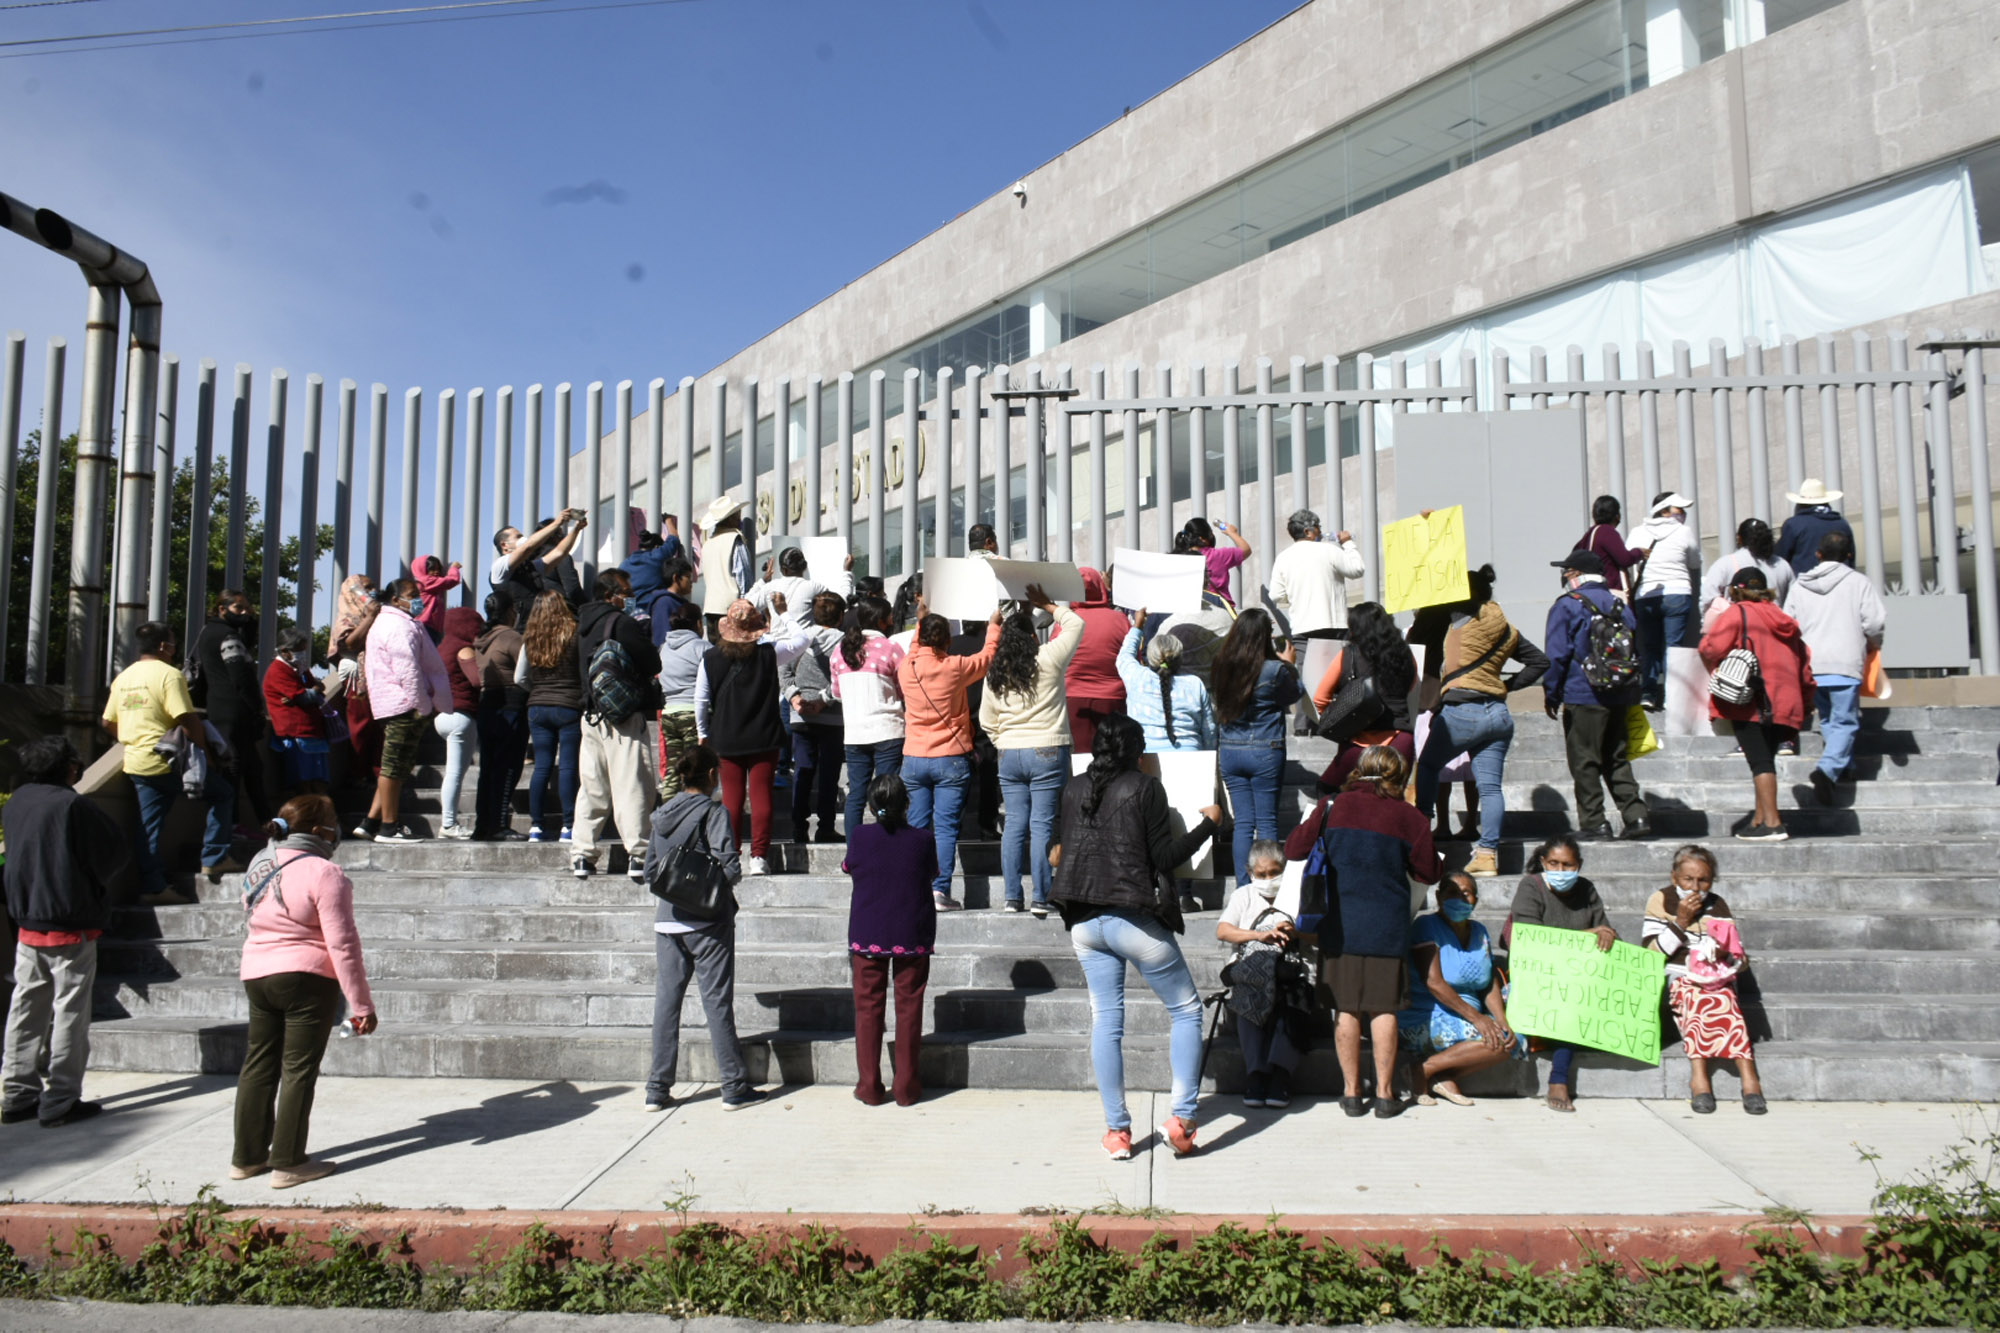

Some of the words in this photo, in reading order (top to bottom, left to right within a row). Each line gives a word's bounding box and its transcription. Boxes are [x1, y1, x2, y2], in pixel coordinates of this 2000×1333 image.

[1387, 571, 1410, 602] EL
[1514, 926, 1596, 955] CARMONA
[1512, 958, 1554, 976] FUERA
[1609, 942, 1656, 972] URIE
[1566, 957, 1658, 996] DELITOS
[1538, 977, 1657, 1025] FABRICAR
[1521, 1003, 1559, 1033] DE
[1578, 1015, 1656, 1061] BASTA
